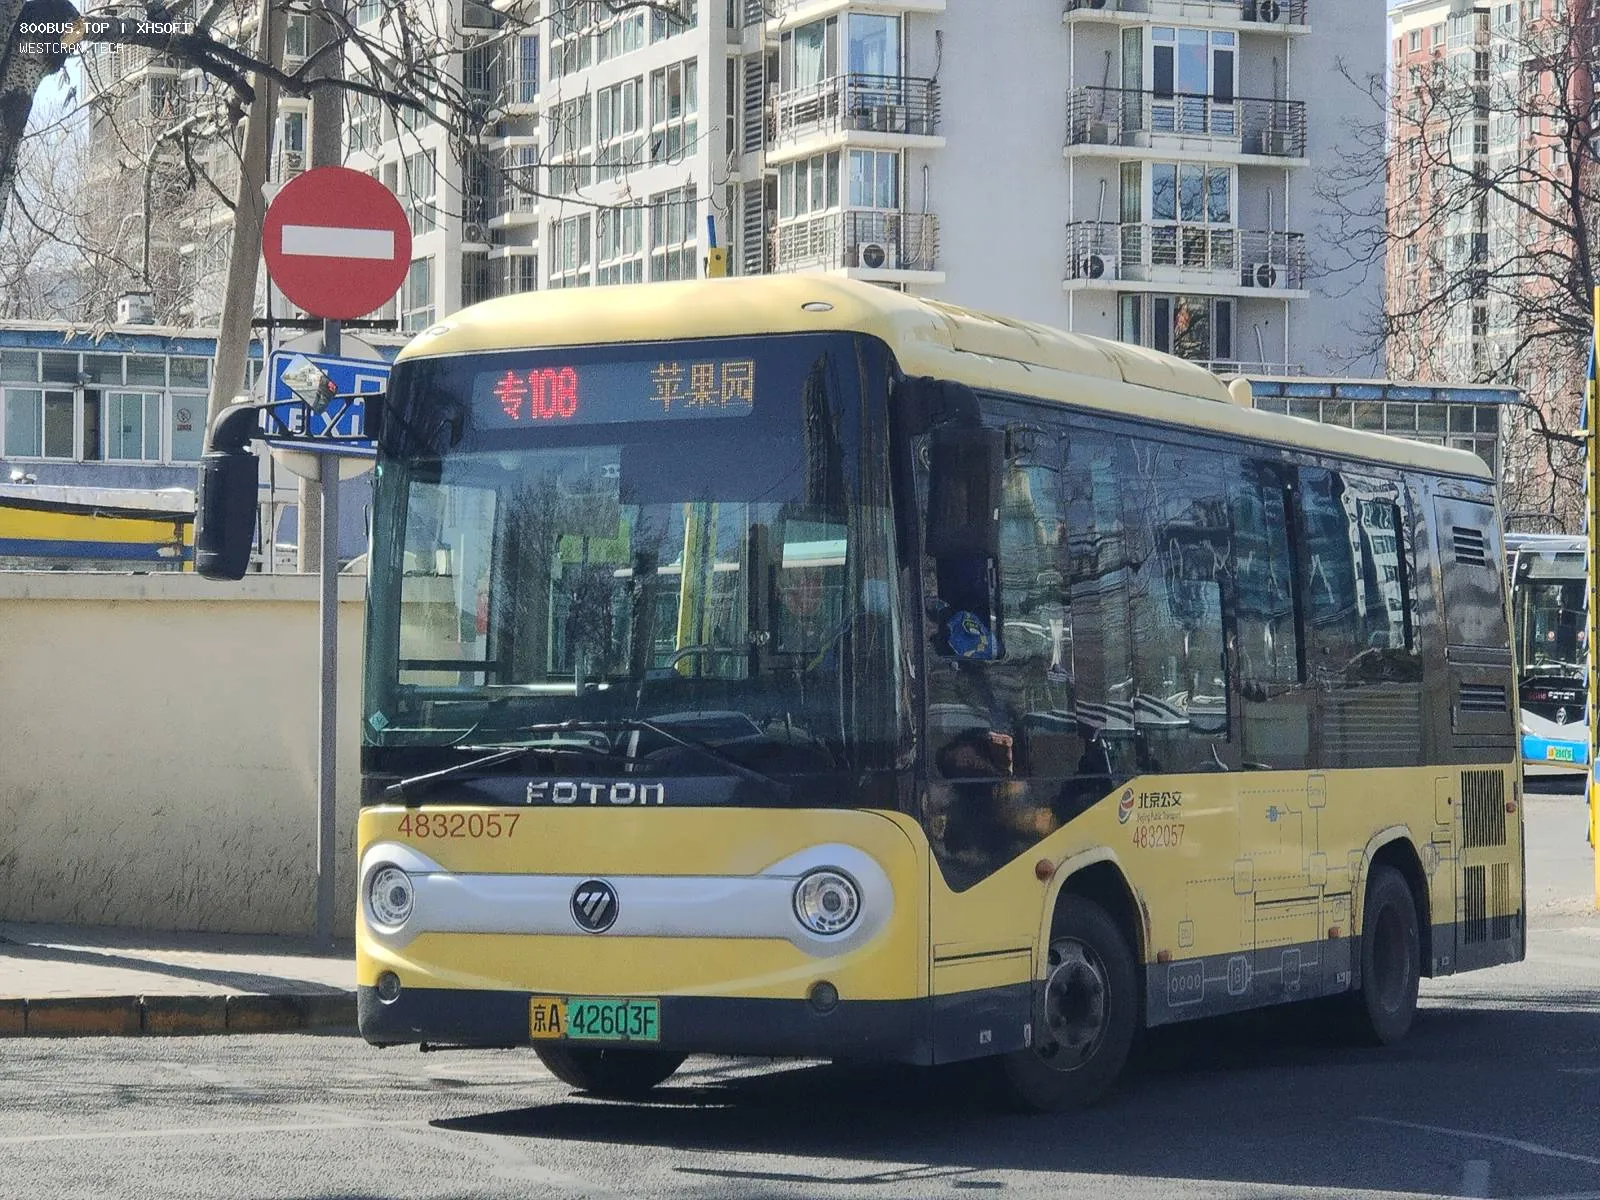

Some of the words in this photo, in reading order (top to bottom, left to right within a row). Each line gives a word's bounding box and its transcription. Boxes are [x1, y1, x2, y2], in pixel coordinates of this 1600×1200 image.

[493, 366, 578, 420] 专108
[649, 359, 754, 413] 苹果园
[526, 781, 665, 805] FOTON
[1138, 792, 1182, 808] 北京公交
[397, 812, 521, 839] 4832057
[1132, 823, 1185, 848] 4832057
[533, 1004, 560, 1033] 京A
[572, 1005, 656, 1035] 42603F
